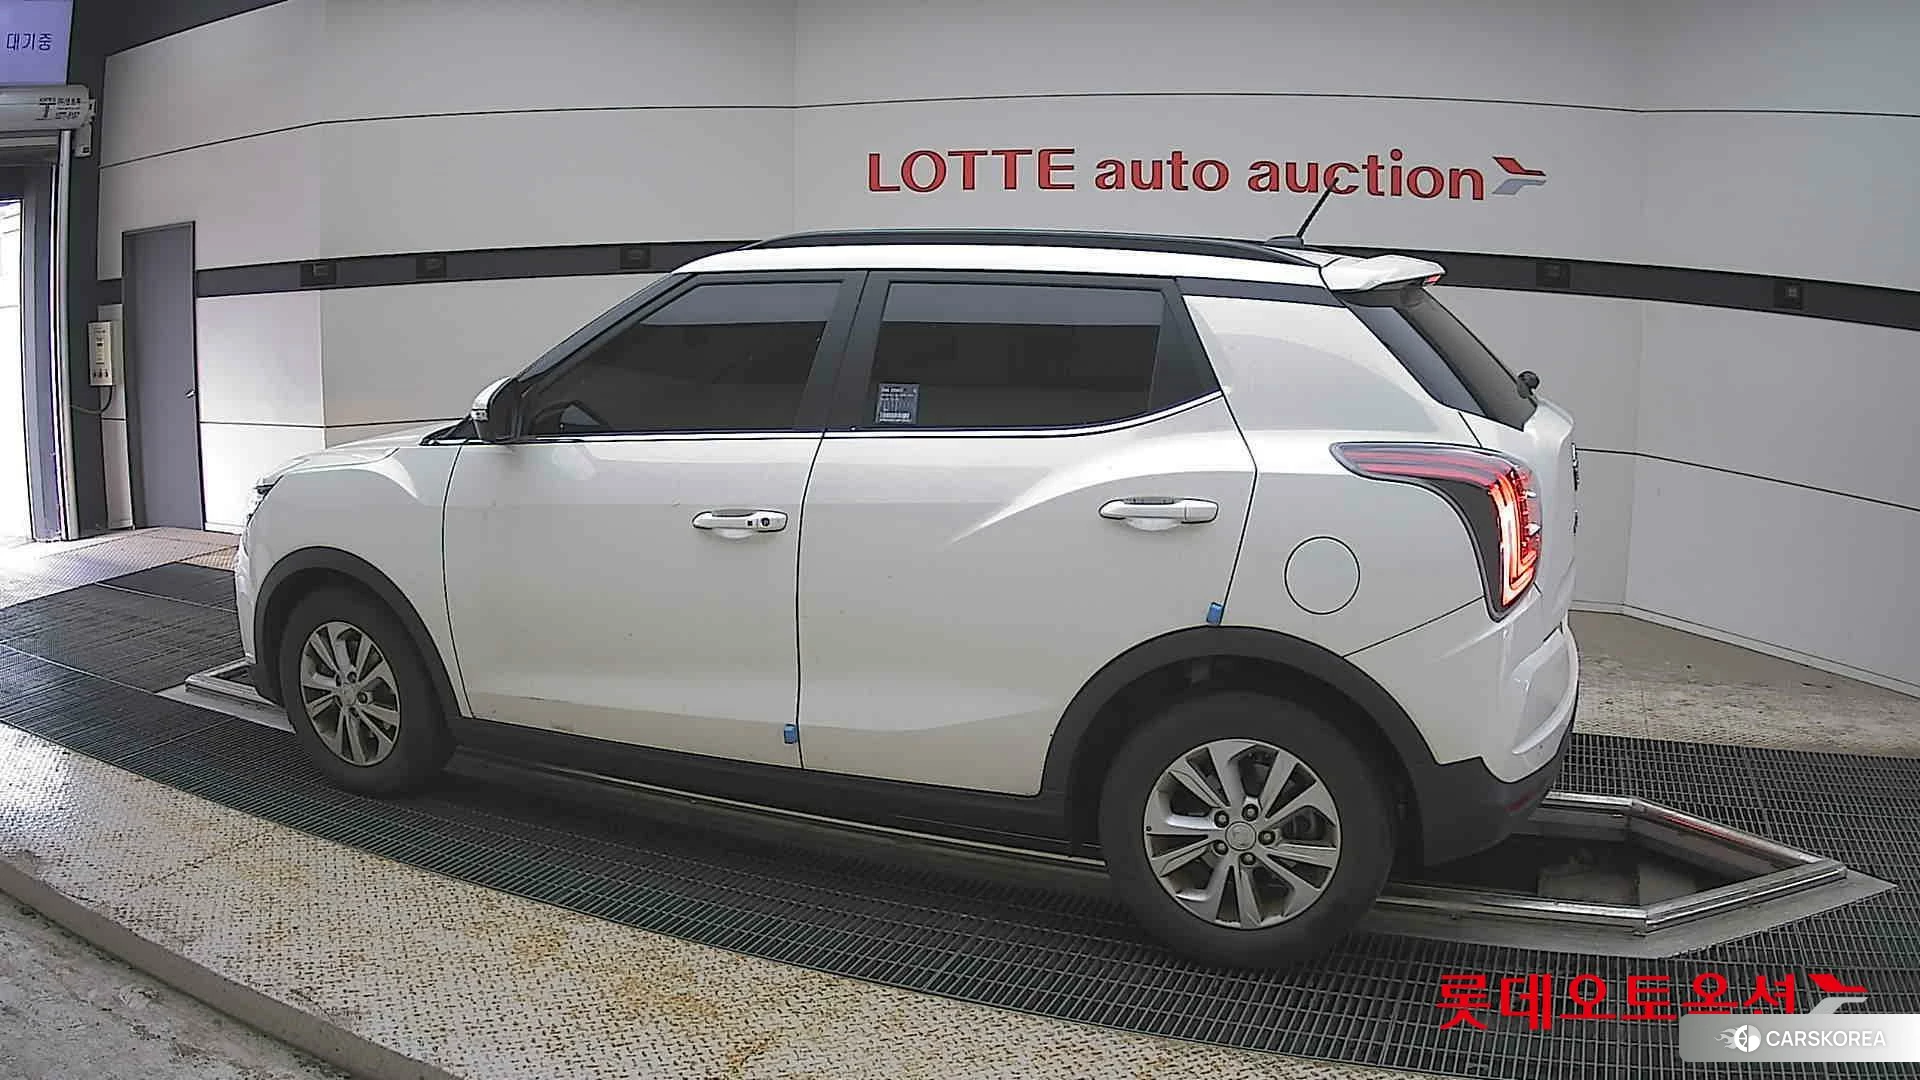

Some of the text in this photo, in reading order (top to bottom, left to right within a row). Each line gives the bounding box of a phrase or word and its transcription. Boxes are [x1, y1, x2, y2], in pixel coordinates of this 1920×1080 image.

[6, 32, 53, 51] 대기중
[867, 148, 1485, 200] LOTTE auto auction
